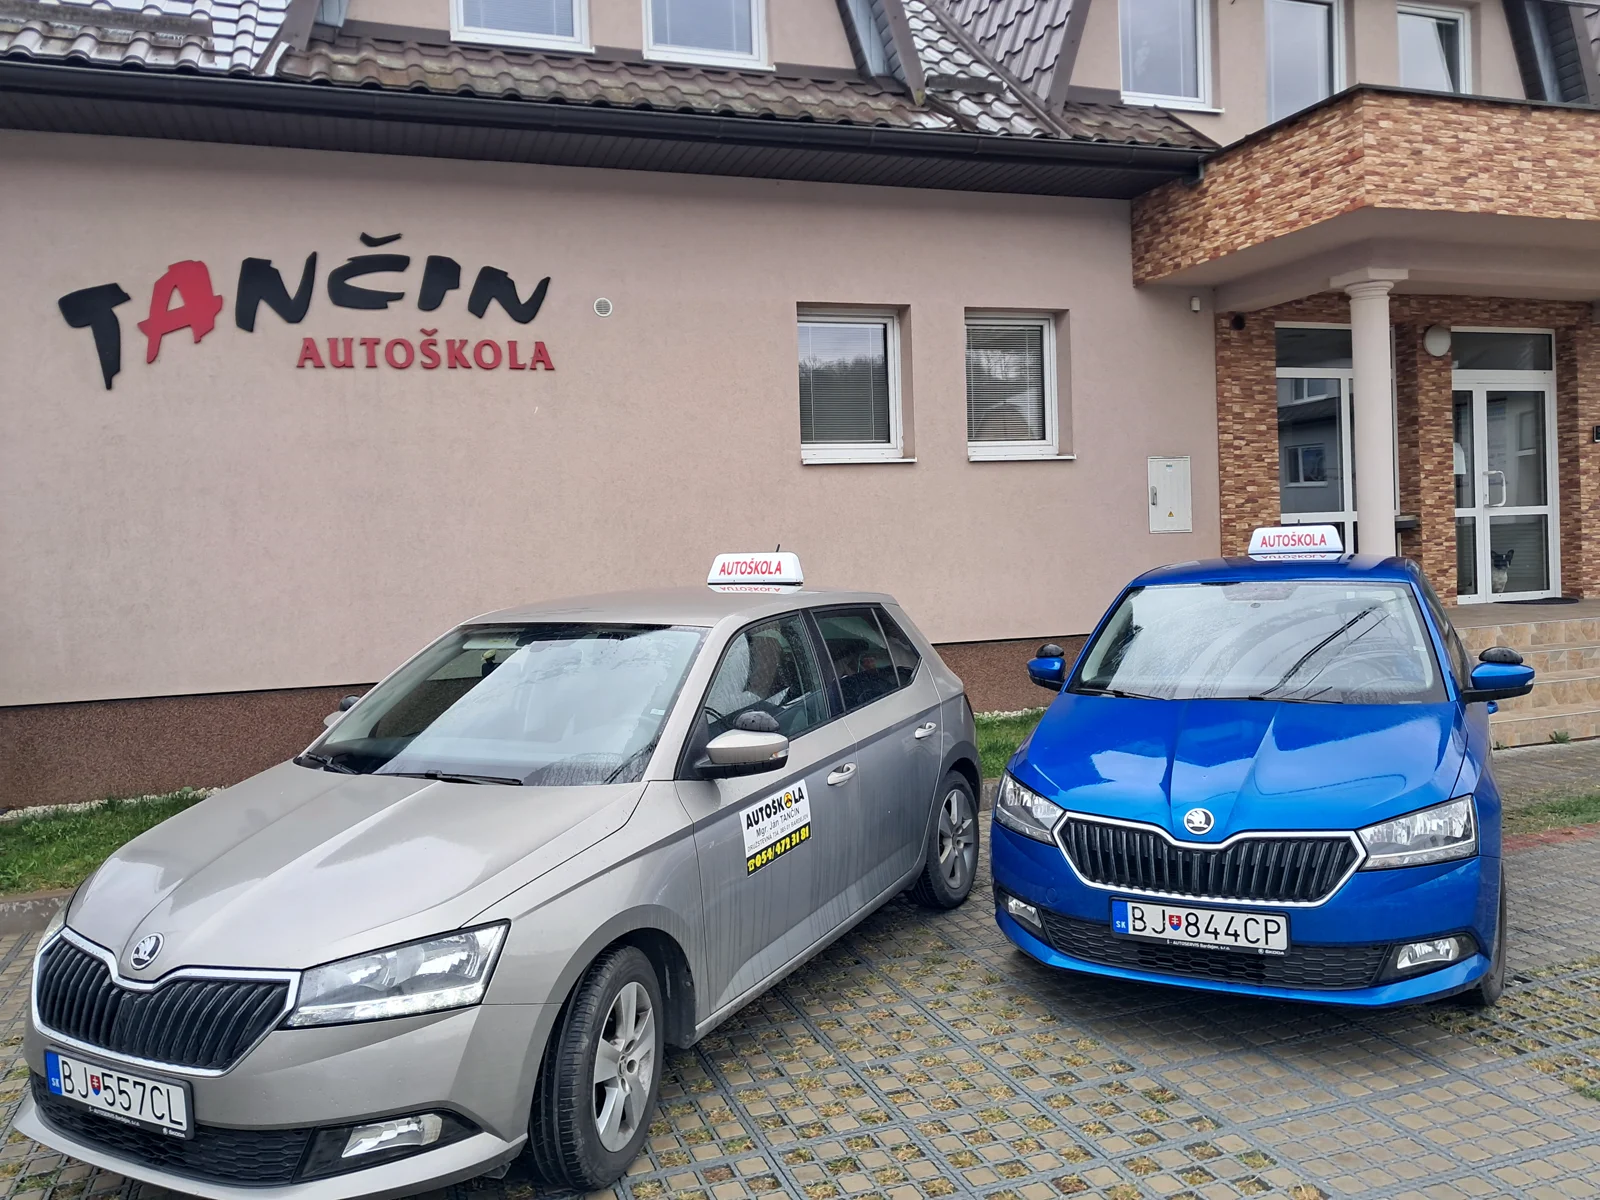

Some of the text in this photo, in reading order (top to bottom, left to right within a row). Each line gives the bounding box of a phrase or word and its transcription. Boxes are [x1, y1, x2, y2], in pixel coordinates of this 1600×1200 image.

[296, 327, 556, 372] AUTOŠKOLA
[1260, 532, 1327, 548] AUTOŠKOLA
[718, 558, 782, 576] AUTOŠKOLA
[791, 831, 800, 847] 31
[801, 825, 809, 841] 81
[1115, 920, 1126, 929] SK
[51, 1077, 60, 1088] SK
